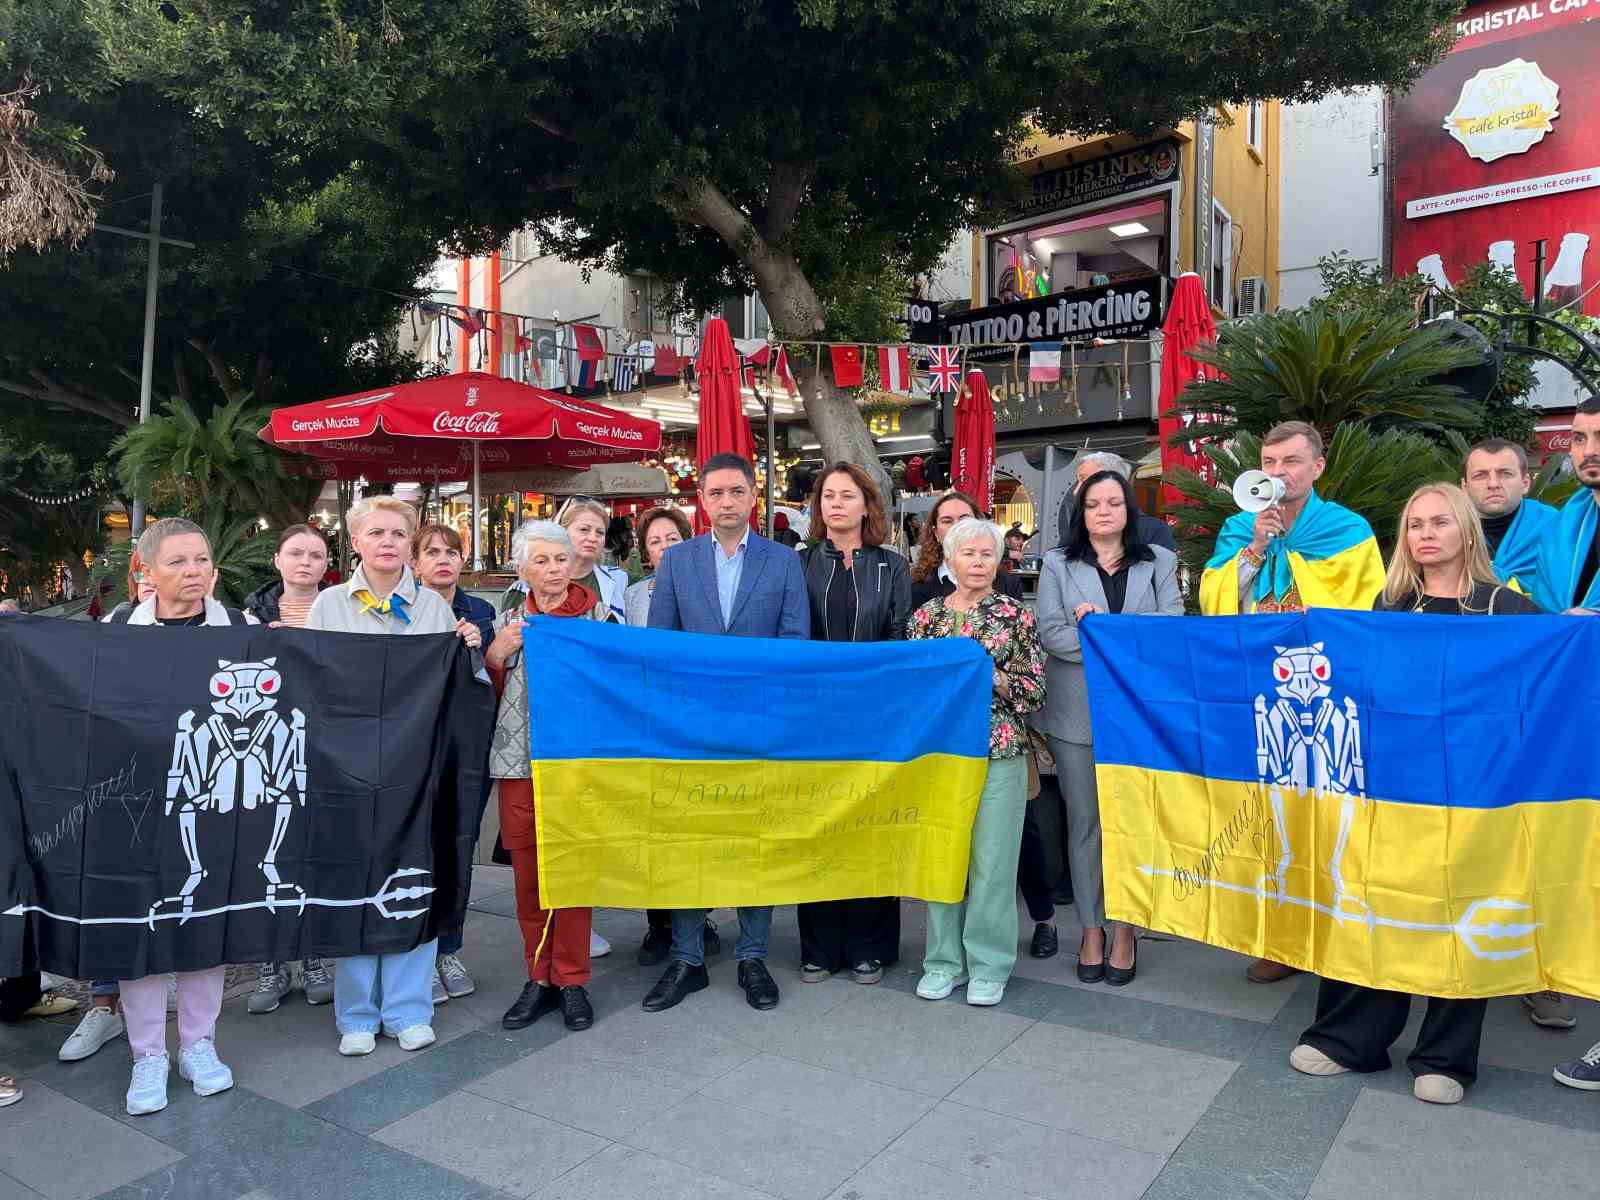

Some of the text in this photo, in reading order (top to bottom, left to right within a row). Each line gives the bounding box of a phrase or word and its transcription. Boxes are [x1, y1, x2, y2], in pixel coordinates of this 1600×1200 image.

[1456, 5, 1544, 38] KRİSTAL
[1468, 105, 1539, 136] cafe kristal
[1074, 173, 1126, 196] PIERCING
[1415, 201, 1441, 212] LATTE
[1495, 183, 1539, 198] ESPRESSO
[1543, 180, 1559, 189] ICE
[1559, 174, 1594, 187] COFFEE
[948, 312, 1023, 345] TATTOO
[1026, 311, 1043, 339] &
[291, 414, 361, 433] Gerçek Mucize
[432, 410, 503, 434] Coca-Cola
[576, 421, 643, 441] Gerçek Mucize
